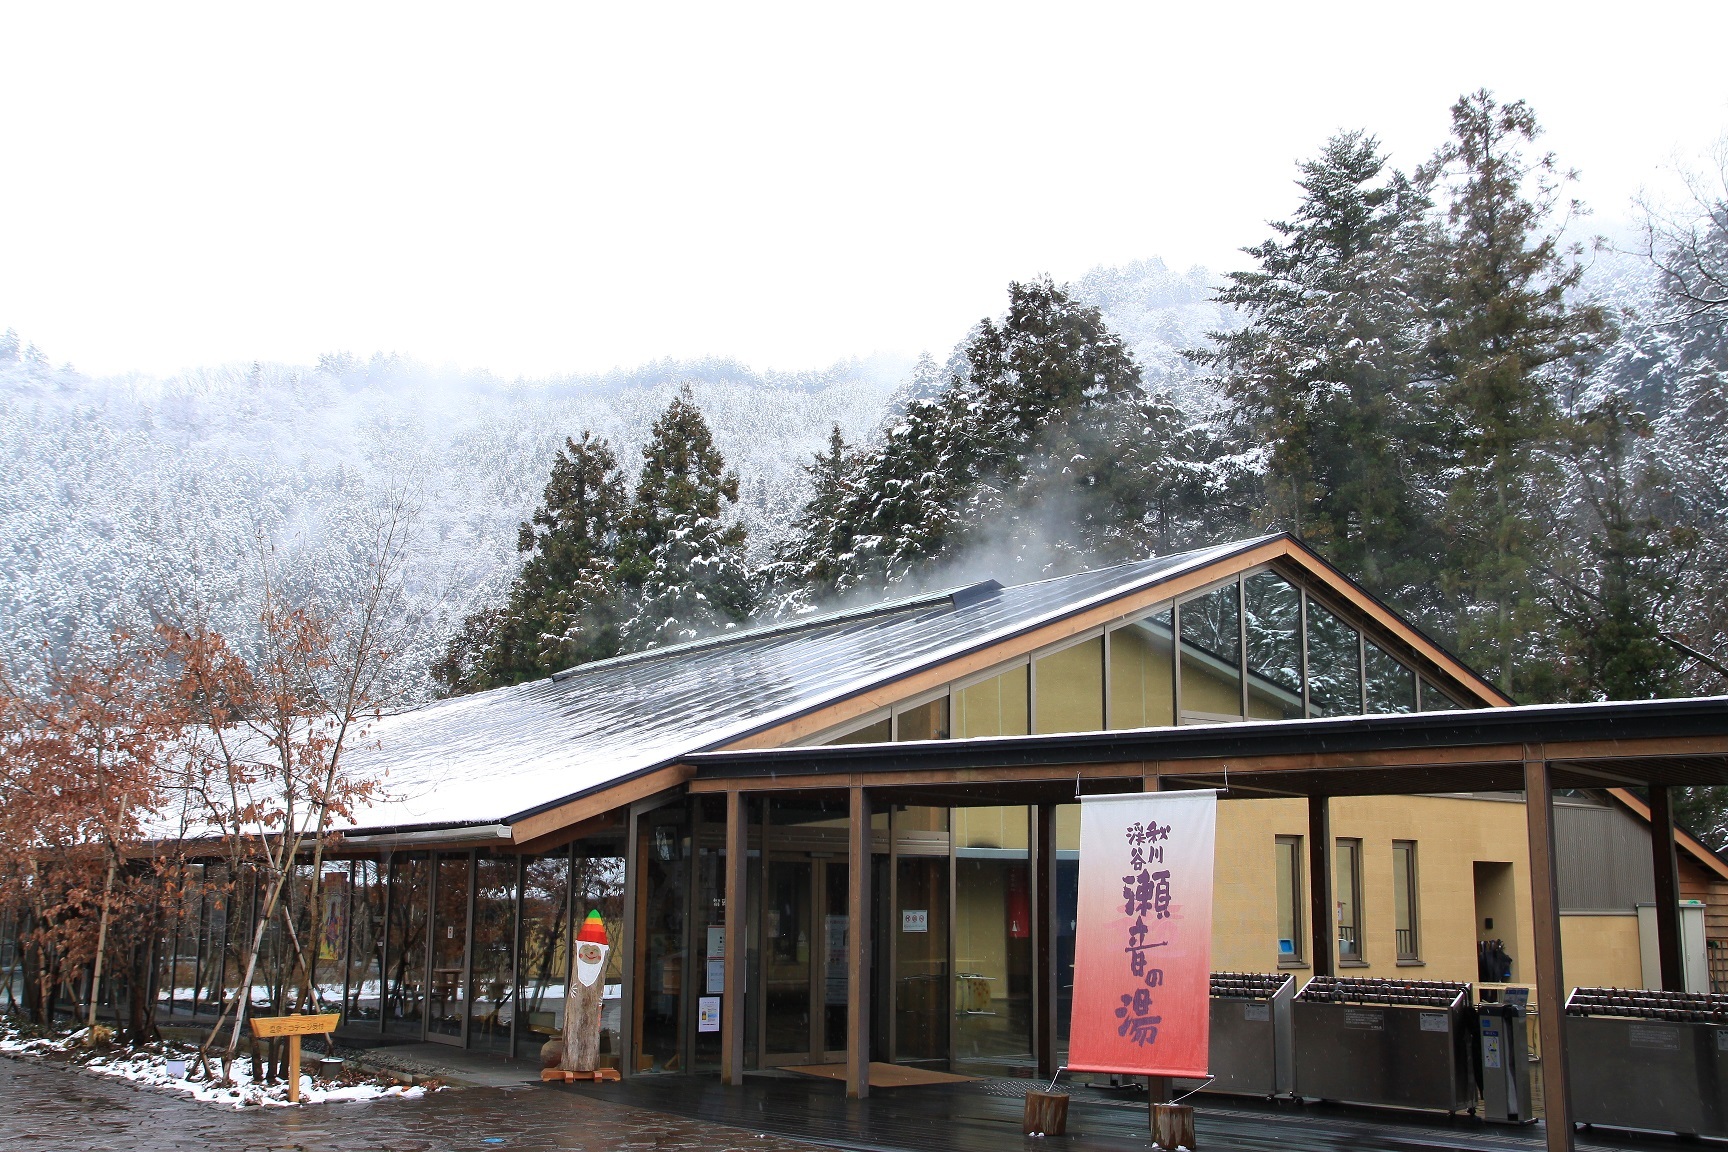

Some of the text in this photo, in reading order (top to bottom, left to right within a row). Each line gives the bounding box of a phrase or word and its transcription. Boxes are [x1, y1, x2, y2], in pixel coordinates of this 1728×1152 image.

[1146, 820, 1171, 864] 秋川
[1115, 869, 1171, 1047] 瀬音の湯
